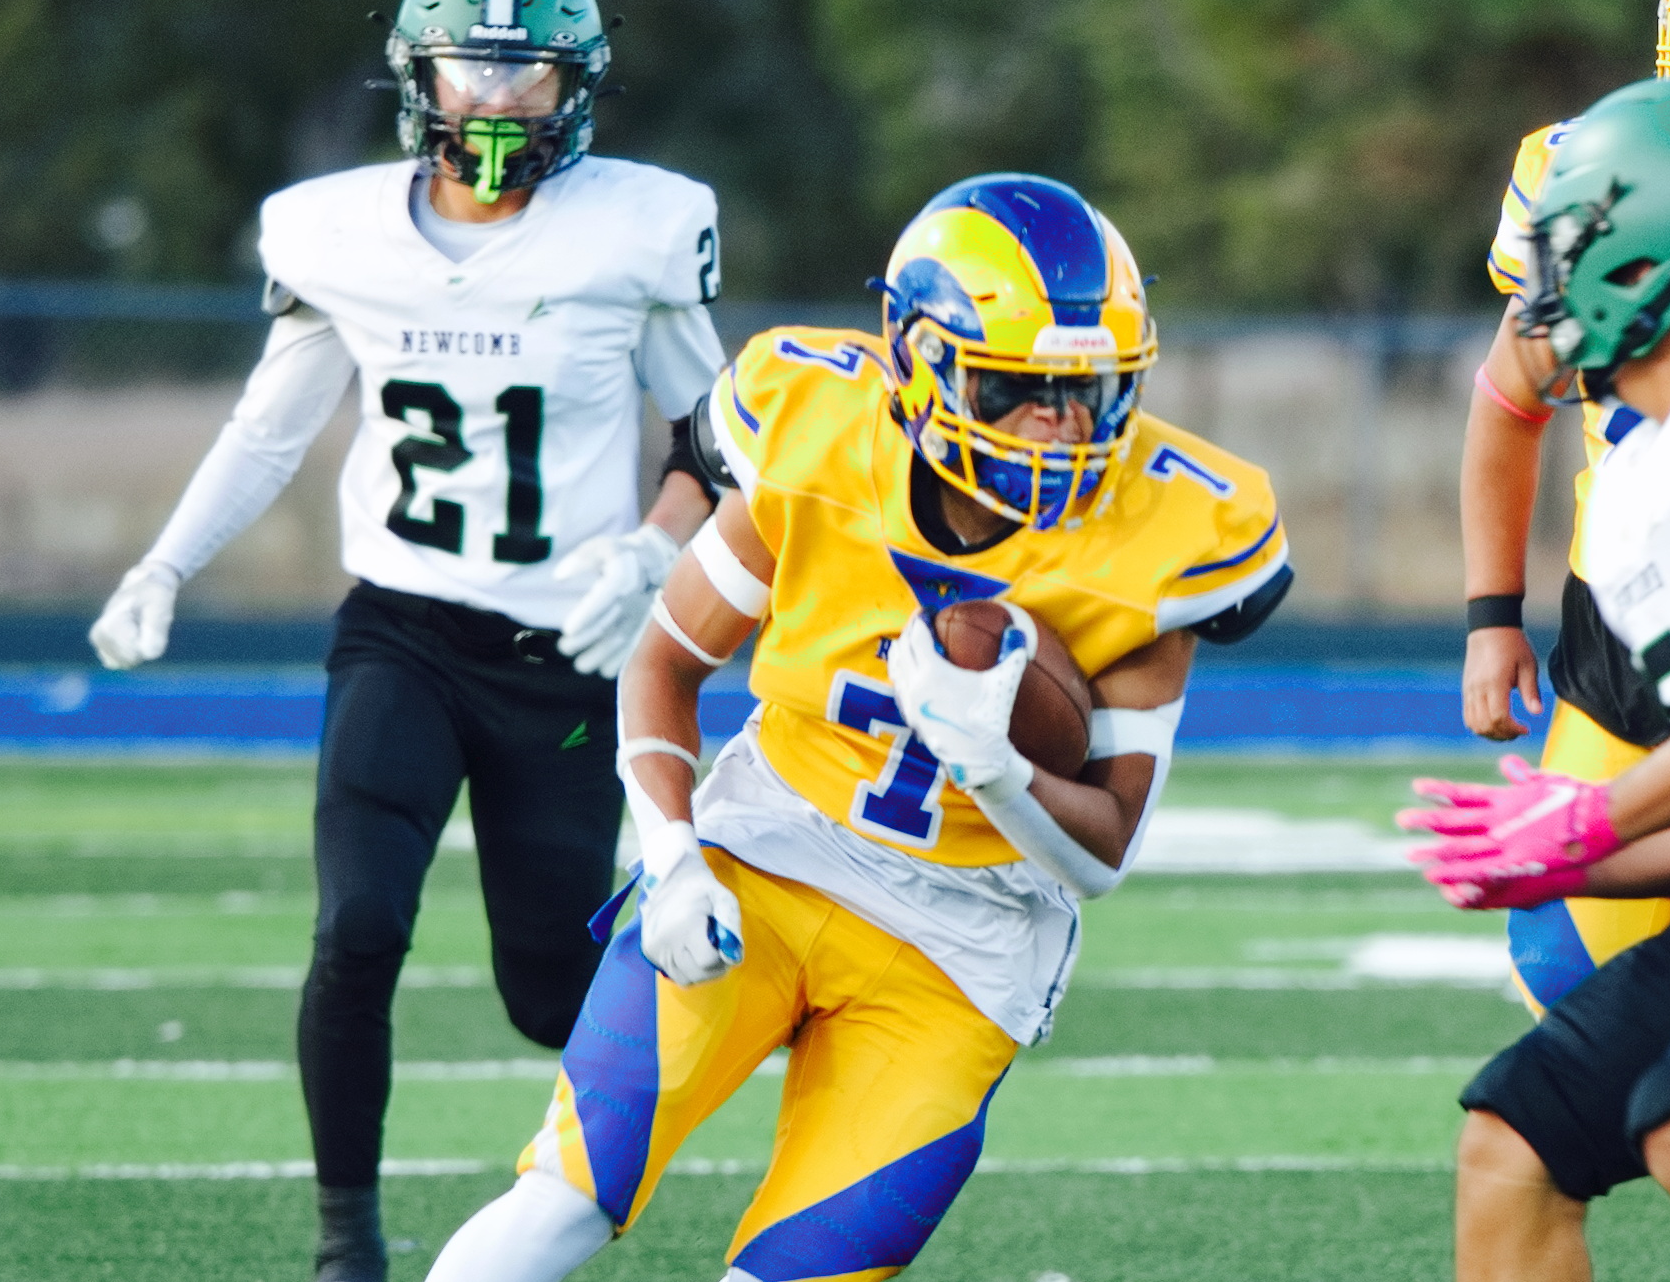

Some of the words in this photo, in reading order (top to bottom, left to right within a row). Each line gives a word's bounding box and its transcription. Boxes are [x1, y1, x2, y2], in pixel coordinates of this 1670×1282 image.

[470, 25, 528, 41] Riddell
[401, 329, 522, 356] NEWCOMB
[381, 378, 552, 564] 21
[1144, 442, 1236, 499] 7
[827, 669, 946, 850] 7
